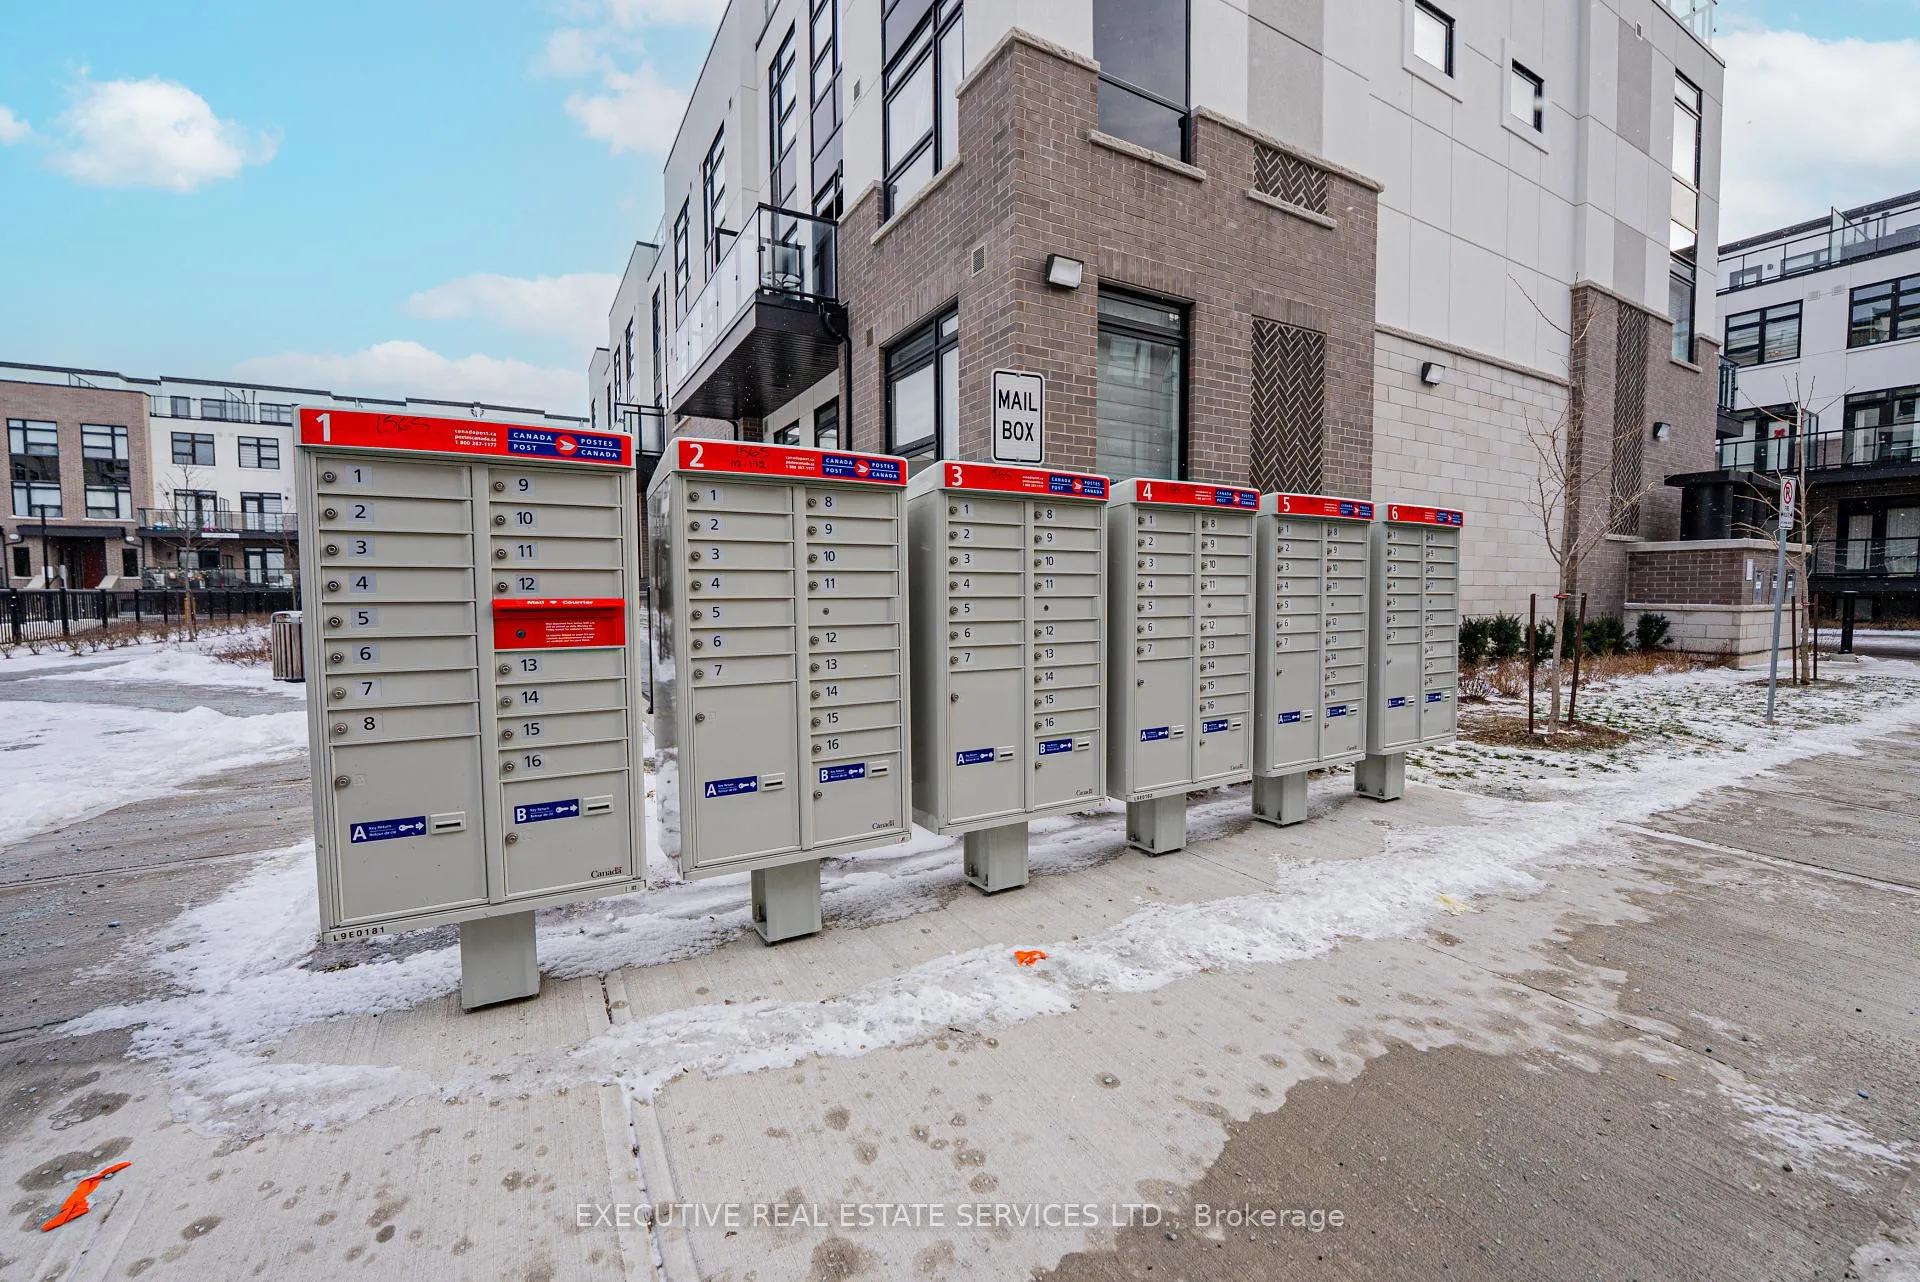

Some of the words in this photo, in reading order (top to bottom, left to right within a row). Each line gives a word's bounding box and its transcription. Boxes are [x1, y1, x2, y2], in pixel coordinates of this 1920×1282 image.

[998, 389, 1038, 412] MAIL
[315, 412, 331, 442] 1
[1002, 420, 1034, 442] BOX
[513, 432, 552, 442] CANADA
[580, 438, 613, 447] POSTES
[513, 443, 537, 451] POST
[581, 449, 618, 458] CANADA
[688, 443, 705, 468] 2
[825, 458, 853, 466] CANADA
[871, 462, 894, 470] POSTES
[353, 469, 362, 483] 1
[871, 471, 897, 479] CANADA
[951, 465, 963, 486] 3
[517, 478, 529, 492] 9
[710, 489, 716, 501] 1
[1142, 482, 1153, 501] 4
[824, 496, 833, 508] 8
[1283, 496, 1290, 512] 5
[354, 504, 367, 519] 2
[964, 504, 969, 515] 1
[1046, 509, 1053, 519] 8
[1391, 506, 1399, 521] 6
[516, 511, 533, 525] 10
[1210, 519, 1216, 528] 8
[710, 518, 719, 531] 2
[825, 523, 833, 535] 9
[963, 528, 970, 539] 2
[1046, 532, 1053, 542] 9
[1148, 536, 1154, 546] 2
[1210, 540, 1215, 548] 9
[355, 540, 367, 555] 3
[517, 544, 533, 558] 11
[711, 548, 720, 560] 3
[823, 550, 836, 562] 10
[964, 554, 971, 564] 3
[1045, 556, 1054, 567] 10
[1148, 558, 1154, 568] 3
[1209, 560, 1216, 569] 10
[355, 575, 369, 590] 4
[518, 577, 535, 591] 12
[711, 577, 721, 589] 4
[824, 577, 836, 589] 11
[963, 579, 971, 589] 4
[1045, 579, 1054, 589] 11
[1148, 580, 1153, 589] 4
[1209, 580, 1216, 589] 11
[964, 603, 970, 614] 5
[1148, 601, 1153, 610] 5
[712, 606, 721, 618] 5
[357, 611, 369, 626] 5
[1148, 623, 1153, 632] 6
[1208, 621, 1215, 629] 12
[964, 628, 971, 639] 6
[1045, 626, 1054, 636] 12
[713, 635, 722, 648] 6
[825, 631, 837, 643] 12
[1148, 644, 1153, 653] 7
[1208, 641, 1215, 649] 13
[360, 646, 372, 661] 6
[964, 652, 971, 663] 7
[1045, 649, 1054, 659] 13
[520, 658, 538, 672] 13
[714, 664, 723, 676] 7
[825, 659, 838, 670] 13
[1207, 661, 1215, 670] 14
[1045, 671, 1054, 681] 14
[361, 682, 373, 696] 7
[1207, 681, 1215, 690] 15
[521, 690, 539, 704] 14
[825, 686, 838, 697] 14
[1045, 694, 1054, 705] 15
[1207, 701, 1215, 709] 16
[826, 712, 839, 724] 15
[1045, 717, 1055, 727] 16
[363, 717, 376, 731] 8
[522, 722, 540, 736] 15
[1203, 723, 1208, 733] B
[1140, 731, 1147, 741] A
[826, 739, 839, 750] 16
[1040, 743, 1046, 754] B
[523, 754, 542, 768] 16
[957, 753, 965, 765] A
[821, 769, 829, 781] B
[706, 783, 717, 797] A
[516, 808, 527, 822] B
[352, 825, 367, 841] A
[590, 867, 622, 879] Canada
[333, 926, 385, 942] L9E0181
